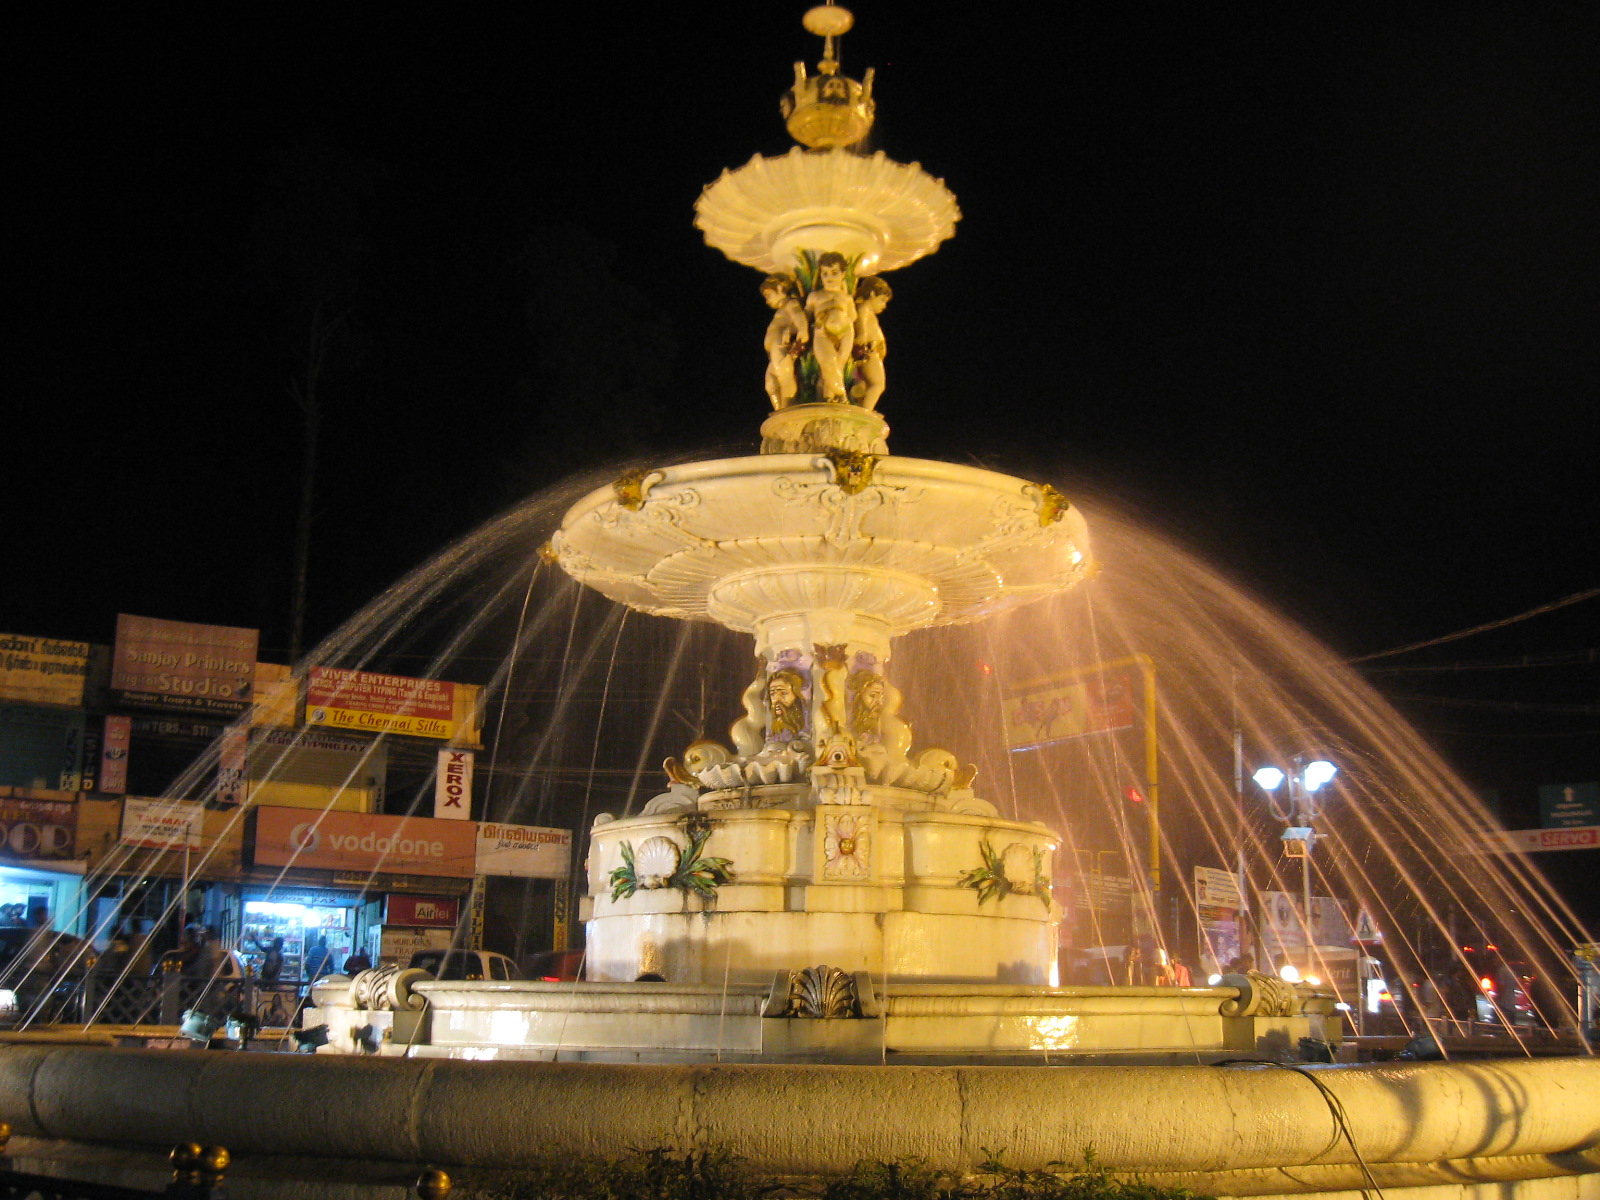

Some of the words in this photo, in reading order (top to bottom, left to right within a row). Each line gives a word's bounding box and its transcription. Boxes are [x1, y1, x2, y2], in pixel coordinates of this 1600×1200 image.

[127, 648, 182, 670] Sanjay
[184, 652, 251, 674] Printers
[158, 672, 233, 698] Studio
[321, 669, 359, 682] VIVEK
[360, 673, 441, 692] ENTERPRISES
[332, 710, 354, 724] The
[358, 712, 412, 731] Chennai
[415, 719, 447, 735] Silks
[443, 752, 465, 808] XEROX
[328, 832, 445, 857] vodafone
[1543, 831, 1592, 846] SERVO
